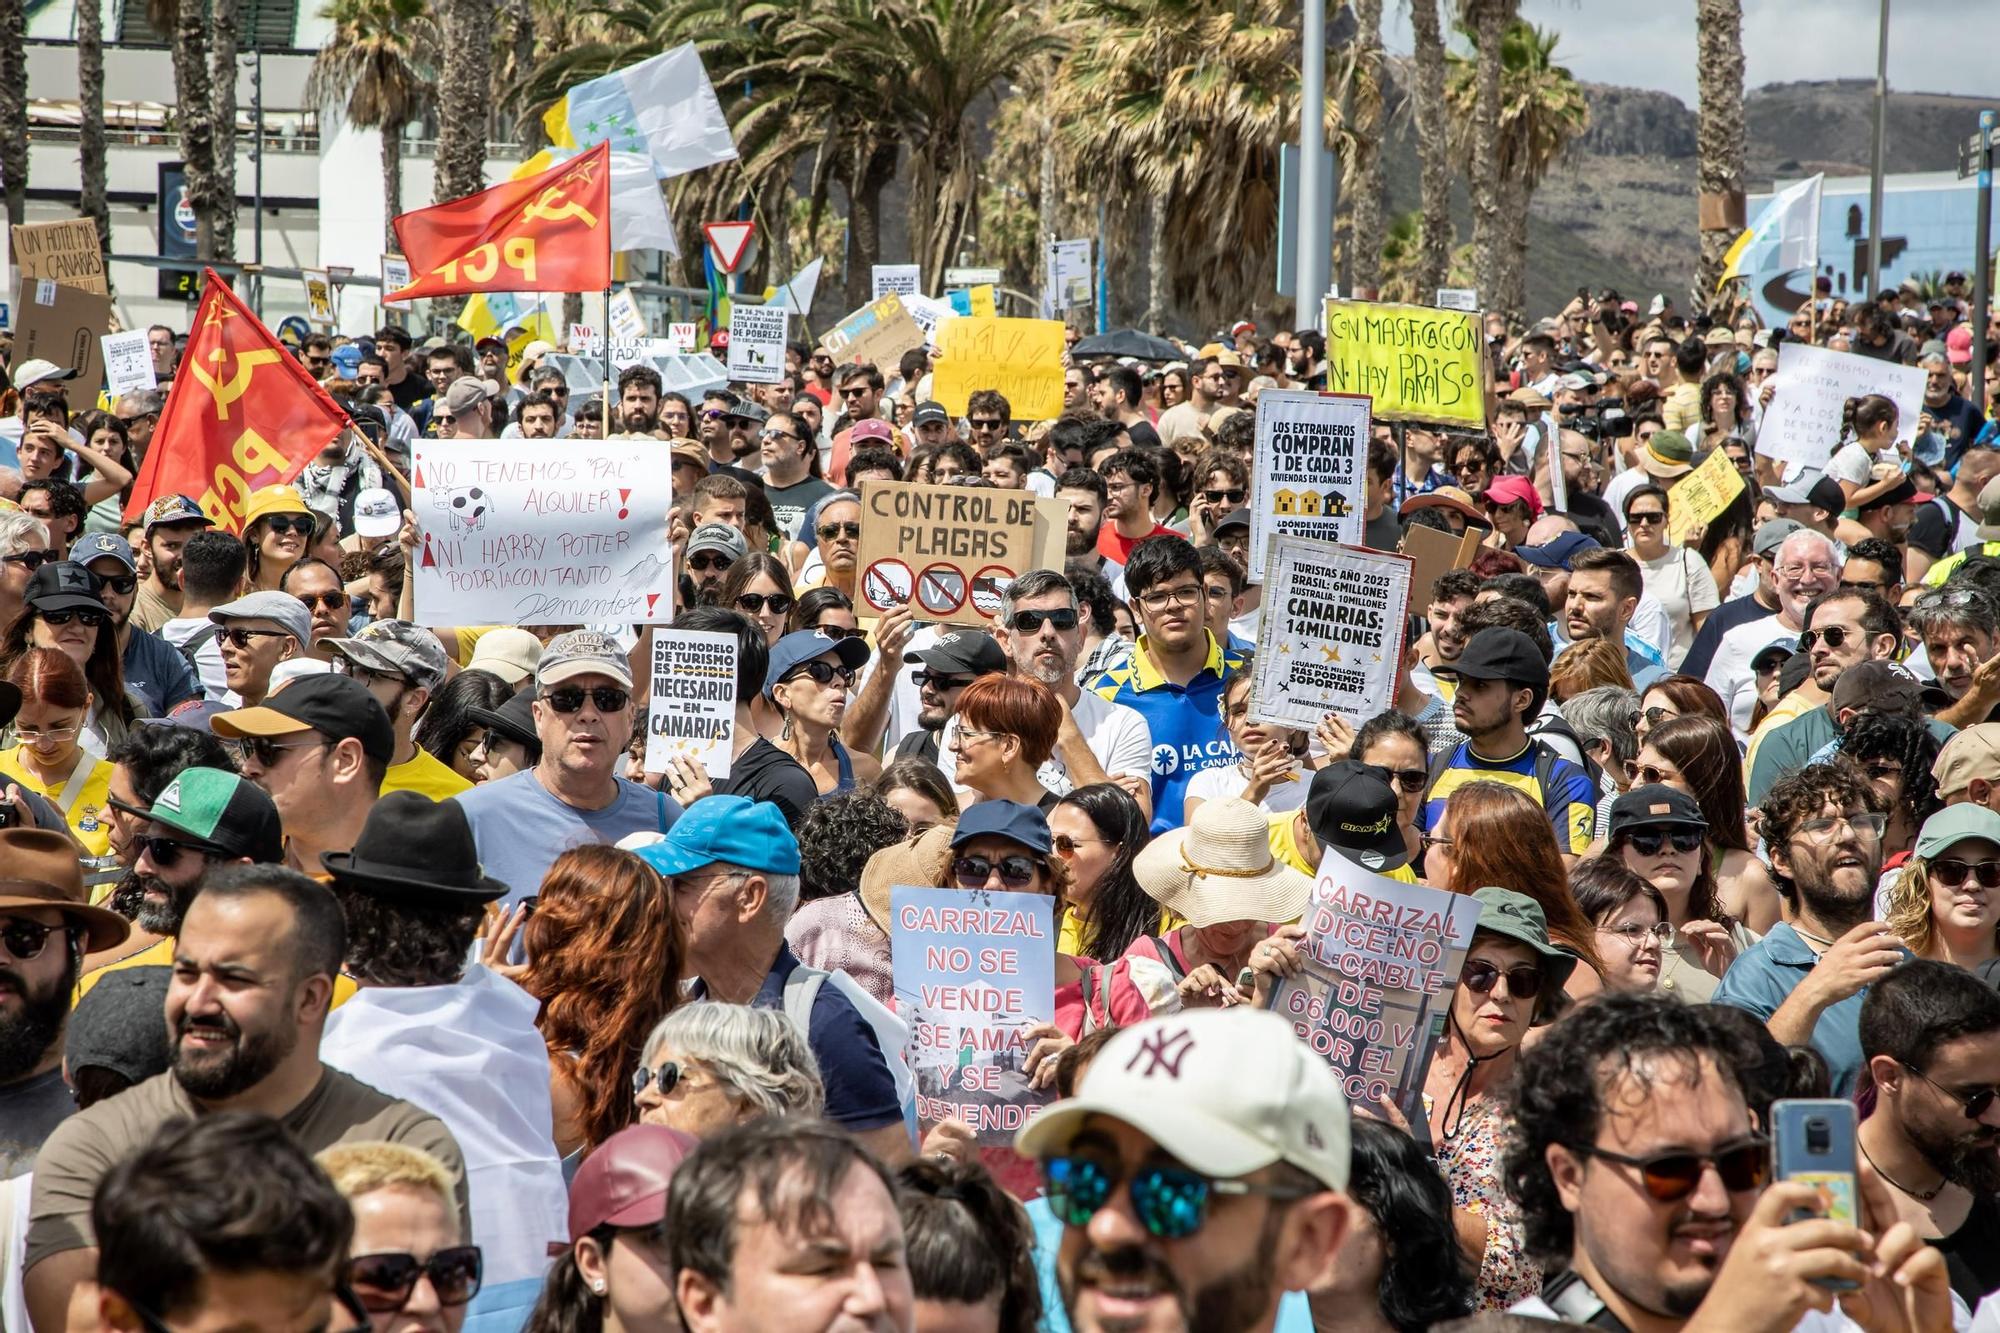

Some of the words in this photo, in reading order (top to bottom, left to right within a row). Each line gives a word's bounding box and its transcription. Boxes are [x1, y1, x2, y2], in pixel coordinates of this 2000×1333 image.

[21, 230, 41, 255] UN
[45, 225, 76, 251] HOTEL
[29, 261, 36, 279] Y
[46, 251, 101, 280] CANARIAS
[673, 325, 691, 337] NO
[733, 328, 743, 337] DE
[746, 329, 782, 340] POBREZA
[1273, 421, 1290, 434] LOS
[1292, 422, 1356, 437] EXTRANJEROS
[1272, 433, 1354, 457] COMPRAN
[470, 459, 577, 483] TENEMOS
[1272, 454, 1280, 471] 1
[1284, 455, 1303, 472] DE
[1306, 456, 1341, 474] CADA
[1344, 458, 1354, 475] 3
[1270, 472, 1308, 483] VIVIENDAS
[1309, 474, 1318, 483] EN
[1319, 475, 1353, 486] CANARIAS
[871, 489, 998, 524] CONTROL
[1006, 497, 1035, 526] DE
[1312, 521, 1339, 530] VAMOS
[482, 535, 547, 565] HARRY
[557, 530, 630, 558] POTTER
[898, 525, 1008, 559] PLAGAS
[554, 565, 613, 586] TANTO
[1291, 574, 1330, 590] BRASIL:
[1333, 581, 1389, 599] 6MILLONES
[1293, 561, 1337, 579] TURISTAS
[1340, 568, 1361, 582] AÑO
[1363, 574, 1390, 587] 2023
[1290, 586, 1335, 601] AUSTRALIA:
[1339, 595, 1387, 610] 10MILLONES
[1287, 598, 1384, 630] CANARIAS:
[1286, 618, 1382, 648] 14MILLONES
[655, 640, 686, 651] OTRO
[688, 643, 734, 654] MODELO
[655, 651, 672, 662] DE
[675, 652, 734, 666] TURISMO
[654, 663, 671, 674] ES
[1314, 670, 1365, 685] PODEMOS
[1331, 667, 1365, 677] MILLONES
[653, 677, 733, 702] NECESARIO
[1289, 674, 1365, 694] SOPORTAR?
[683, 702, 701, 714] EN
[651, 714, 731, 741] CANARIAS
[1183, 743, 1203, 760] LA
[1205, 741, 1240, 757] CAJ
[1184, 762, 1196, 771] DE
[1318, 875, 1461, 940] CARRIZAL
[900, 905, 1045, 938] CARRIZAL
[1313, 907, 1389, 956] DICE
[1393, 934, 1442, 966] NO
[926, 946, 971, 973] NO
[979, 949, 1019, 975] SE
[1295, 932, 1331, 967] AL
[1339, 951, 1446, 995] CABLE
[920, 984, 1024, 1013] VENDE
[1336, 980, 1384, 1014] DE
[1288, 988, 1385, 1044] 66.000
[1393, 1023, 1415, 1049] V.
[918, 1023, 951, 1049] SE
[959, 1027, 1029, 1053] AMA
[1359, 1049, 1398, 1076] EL
[937, 1064, 956, 1090] Y
[961, 1065, 1002, 1091] SE
